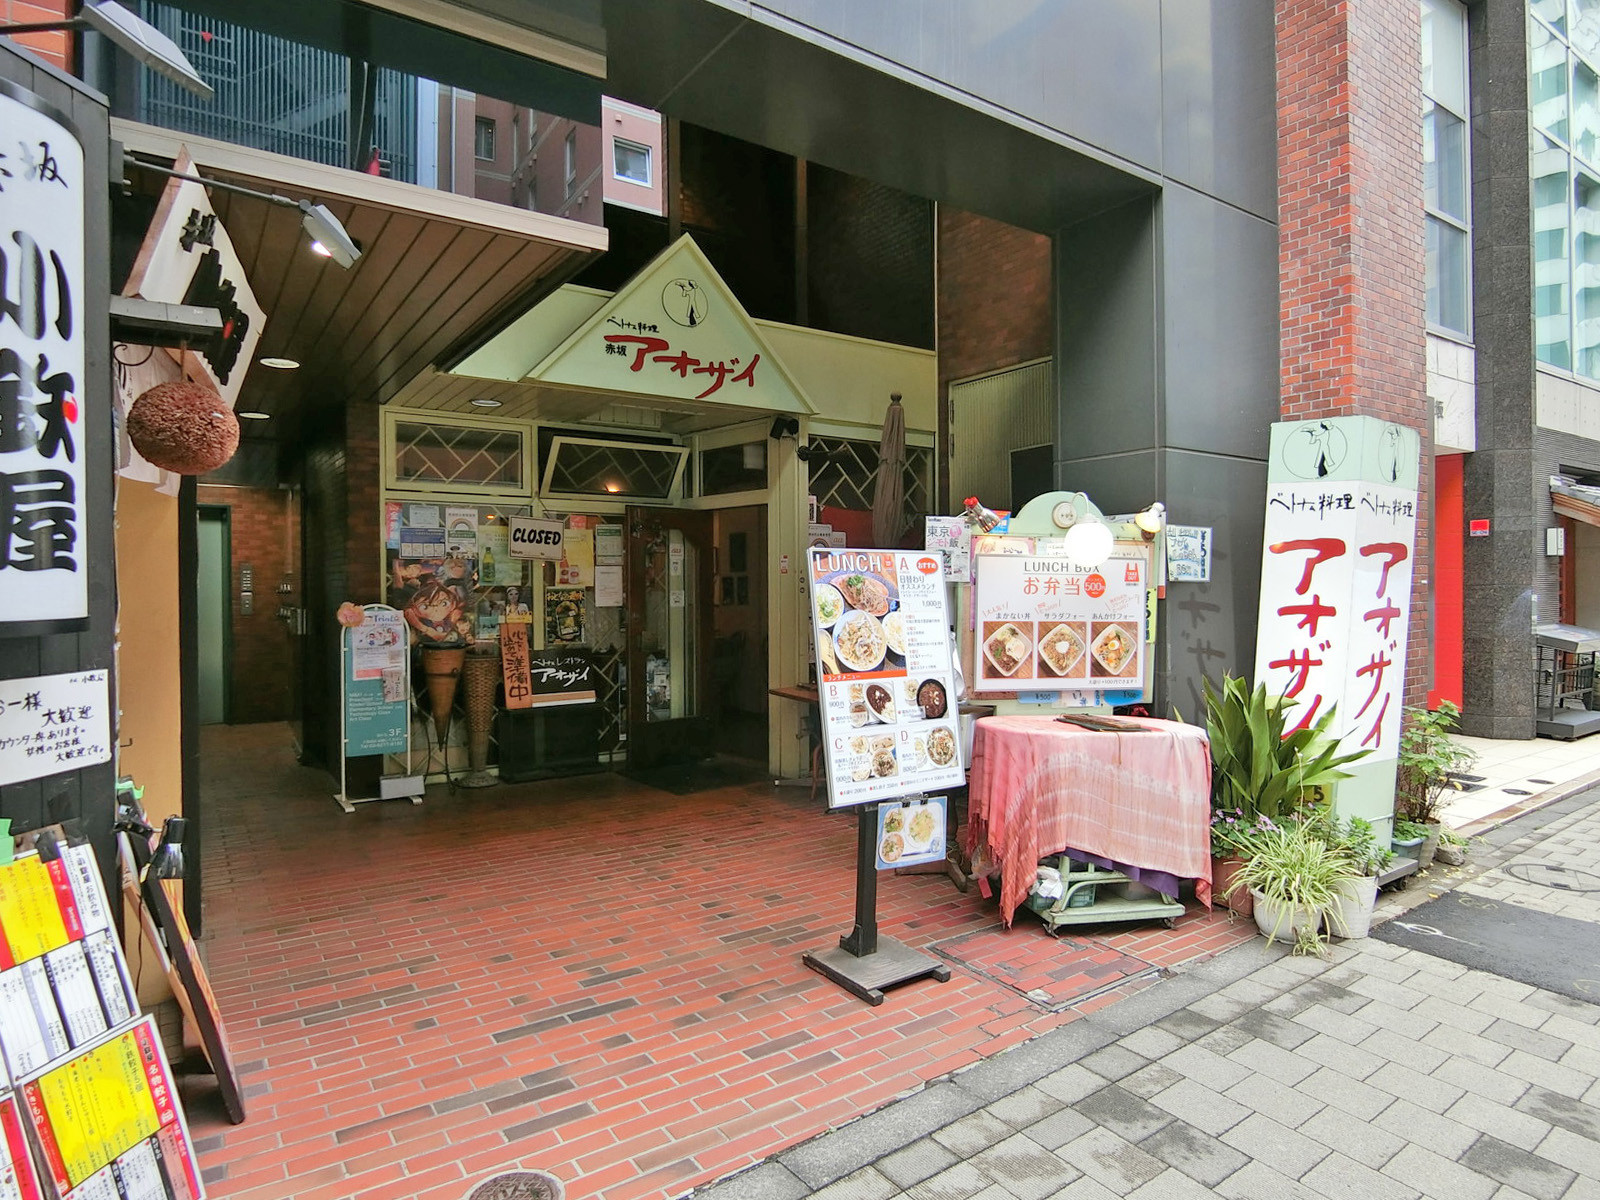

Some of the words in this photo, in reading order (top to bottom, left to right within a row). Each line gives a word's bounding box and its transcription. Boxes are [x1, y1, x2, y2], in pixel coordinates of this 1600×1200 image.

[605, 343, 627, 357] 赤坂
[604, 335, 760, 400] アオザイ
[1269, 492, 1356, 521] ベトナム料理
[1360, 494, 1414, 526] ベトナム料理
[512, 527, 562, 546] CLOSED
[927, 525, 950, 538] 東京
[816, 553, 882, 573] LUNCH
[900, 557, 910, 571] A
[1024, 561, 1069, 573] LUNCH
[1023, 576, 1081, 597] お弁当
[995, 612, 1031, 620] まかない丼
[1044, 612, 1086, 620] サラダフォー
[1355, 542, 1408, 749] アオザイ
[505, 656, 529, 701] 準備中
[531, 666, 591, 688] アオザイ
[829, 684, 838, 697] B
[41, 705, 95, 728] 大歓迎
[388, 728, 402, 737] 3F
[900, 730, 908, 742] D
[834, 738, 843, 750] C
[1313, 785, 1325, 802] 5
